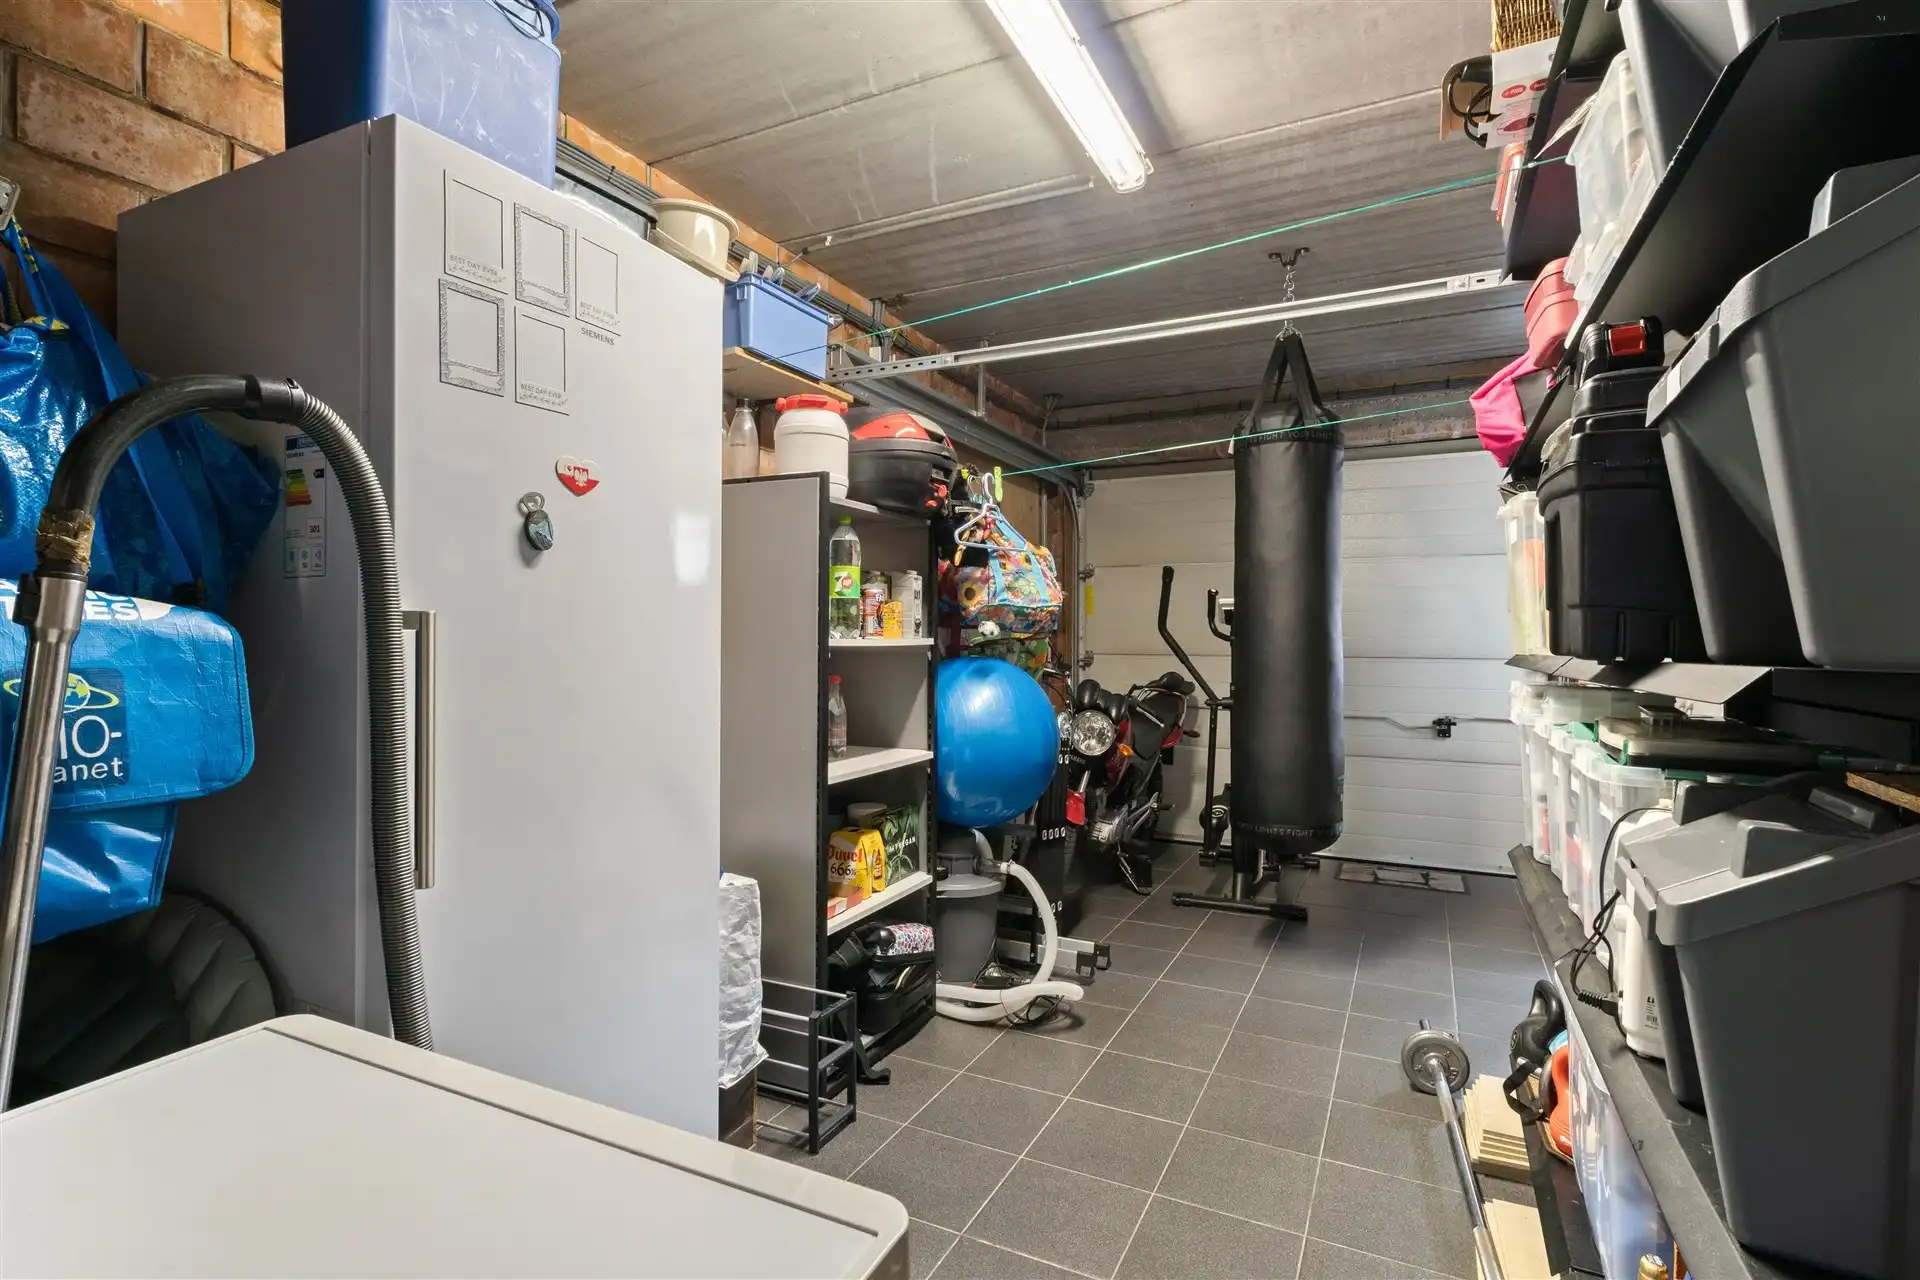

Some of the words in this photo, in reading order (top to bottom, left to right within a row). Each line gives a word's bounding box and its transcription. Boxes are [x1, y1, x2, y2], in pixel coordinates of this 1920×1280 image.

[450, 254, 465, 265] BEST
[467, 260, 481, 270] DAY
[483, 266, 498, 276] EVER
[581, 327, 614, 346] SIEMENS
[520, 383, 535, 392] BEST
[535, 387, 547, 395] DAY
[548, 391, 562, 399] EVER
[53, 756, 124, 783] anet
